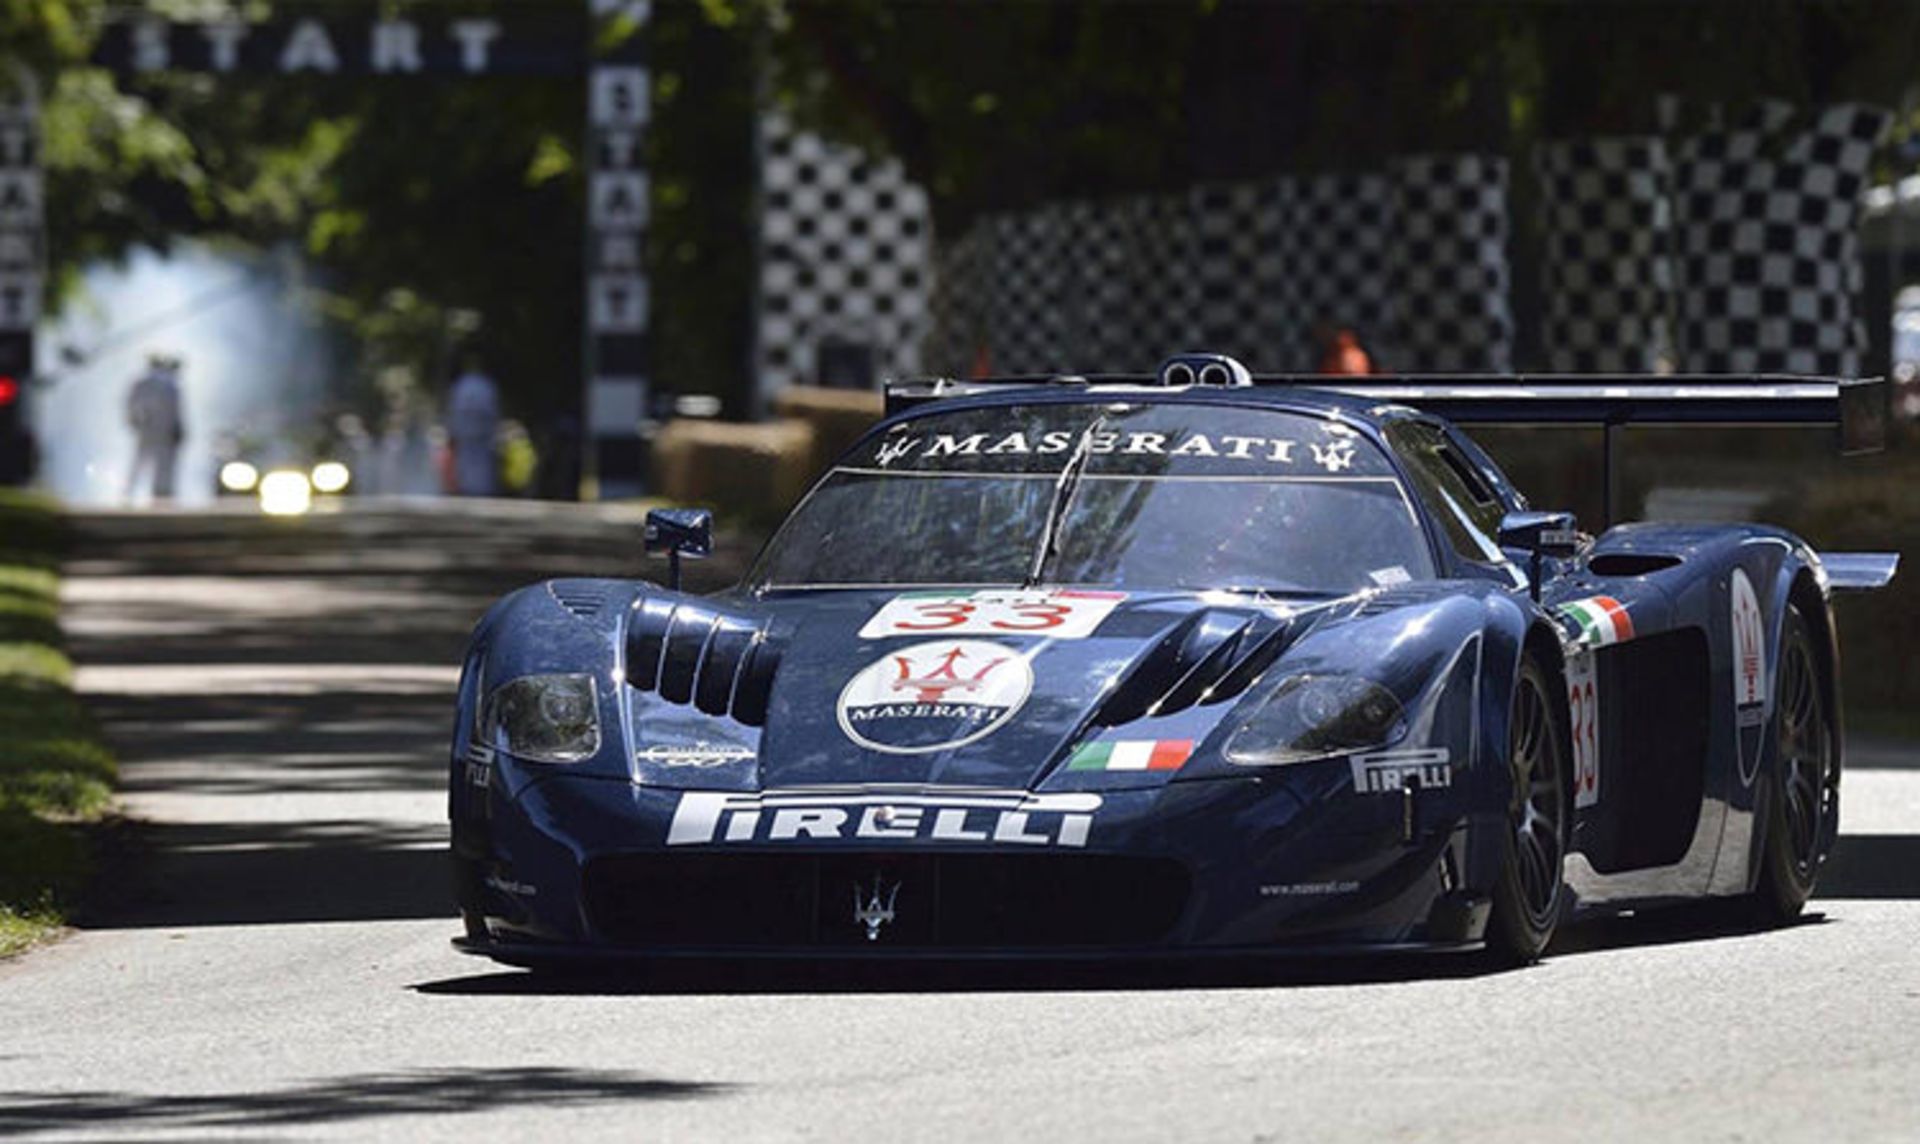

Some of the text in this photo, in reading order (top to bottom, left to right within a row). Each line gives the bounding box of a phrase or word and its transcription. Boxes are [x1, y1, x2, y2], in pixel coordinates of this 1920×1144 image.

[130, 19, 500, 73] START
[600, 76, 643, 322] START
[921, 431, 1295, 463] MASERATI
[893, 603, 1073, 630] 33
[852, 704, 1000, 724] MASERATI
[666, 790, 1104, 846] PIRELLI
